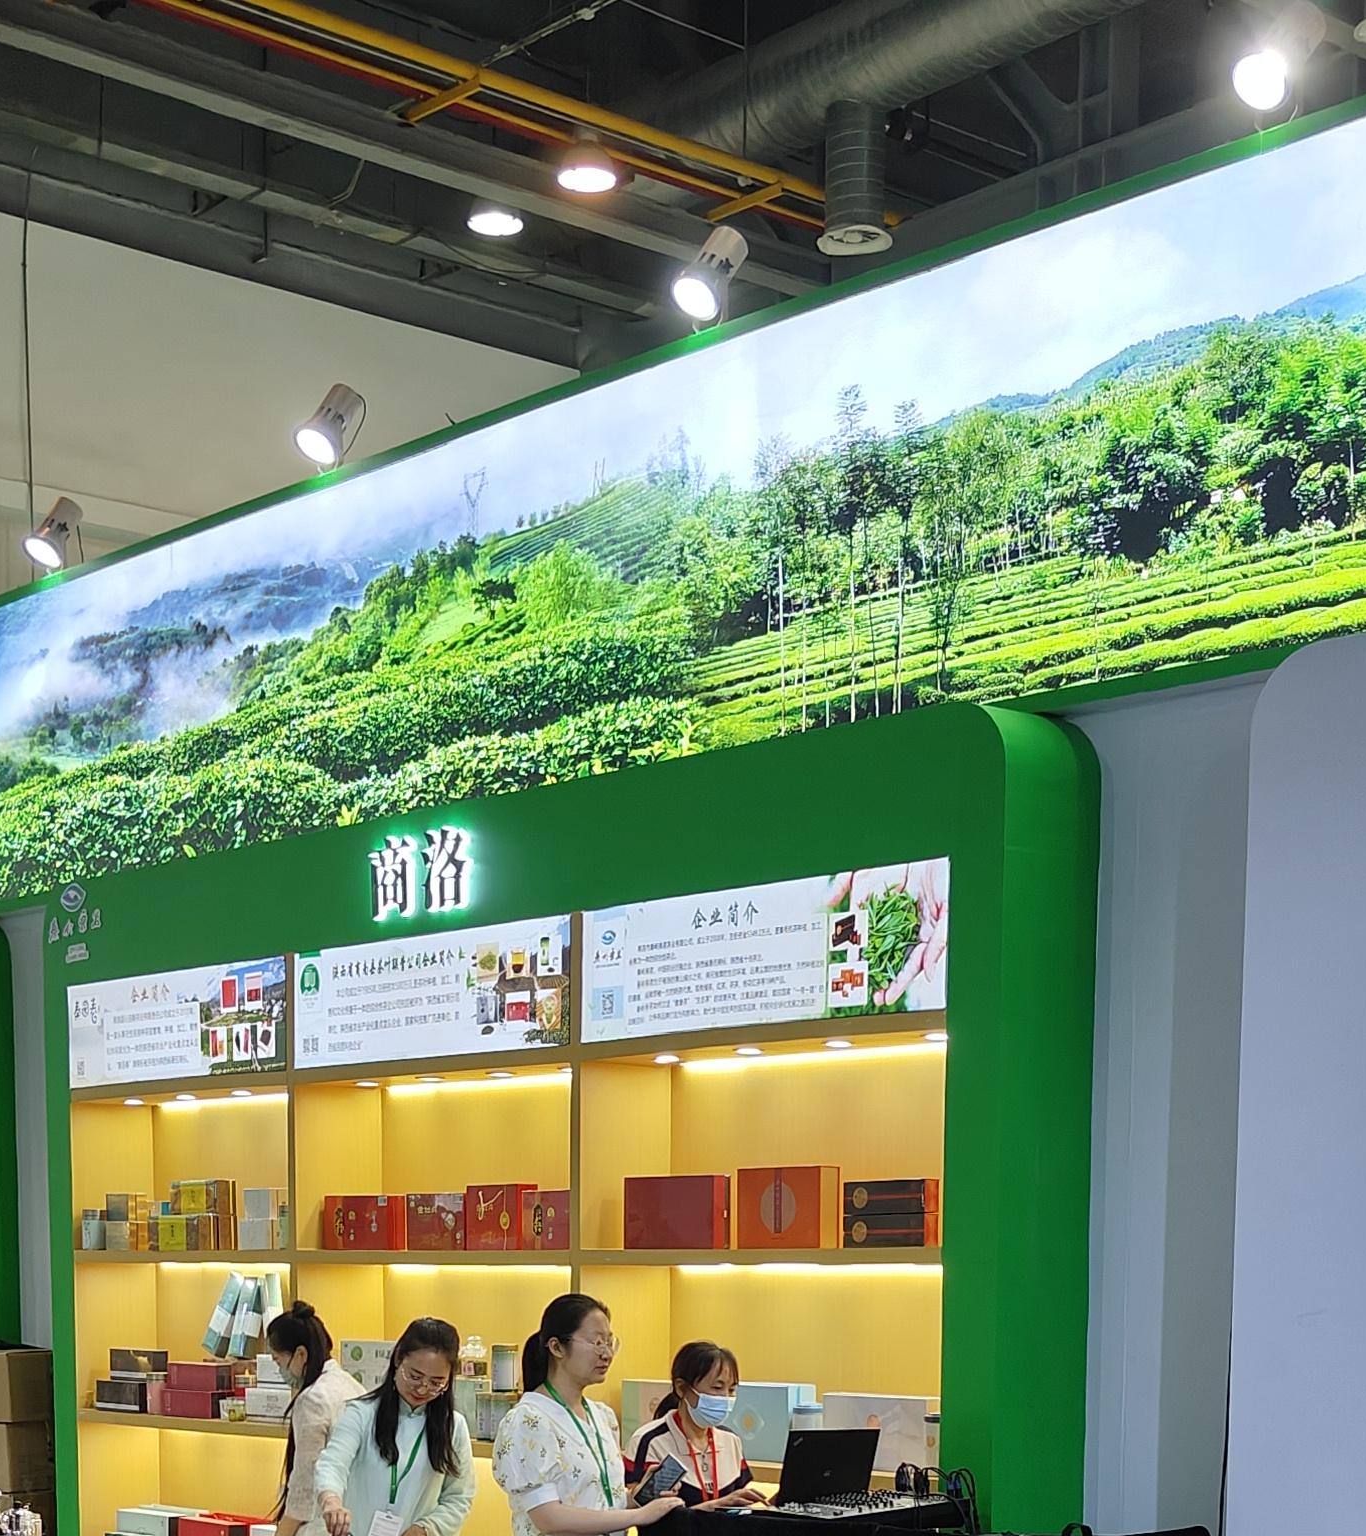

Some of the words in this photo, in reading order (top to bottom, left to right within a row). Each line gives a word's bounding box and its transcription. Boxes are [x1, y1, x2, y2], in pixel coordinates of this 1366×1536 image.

[367, 825, 474, 921] 商洛
[691, 900, 760, 930] 企业简介
